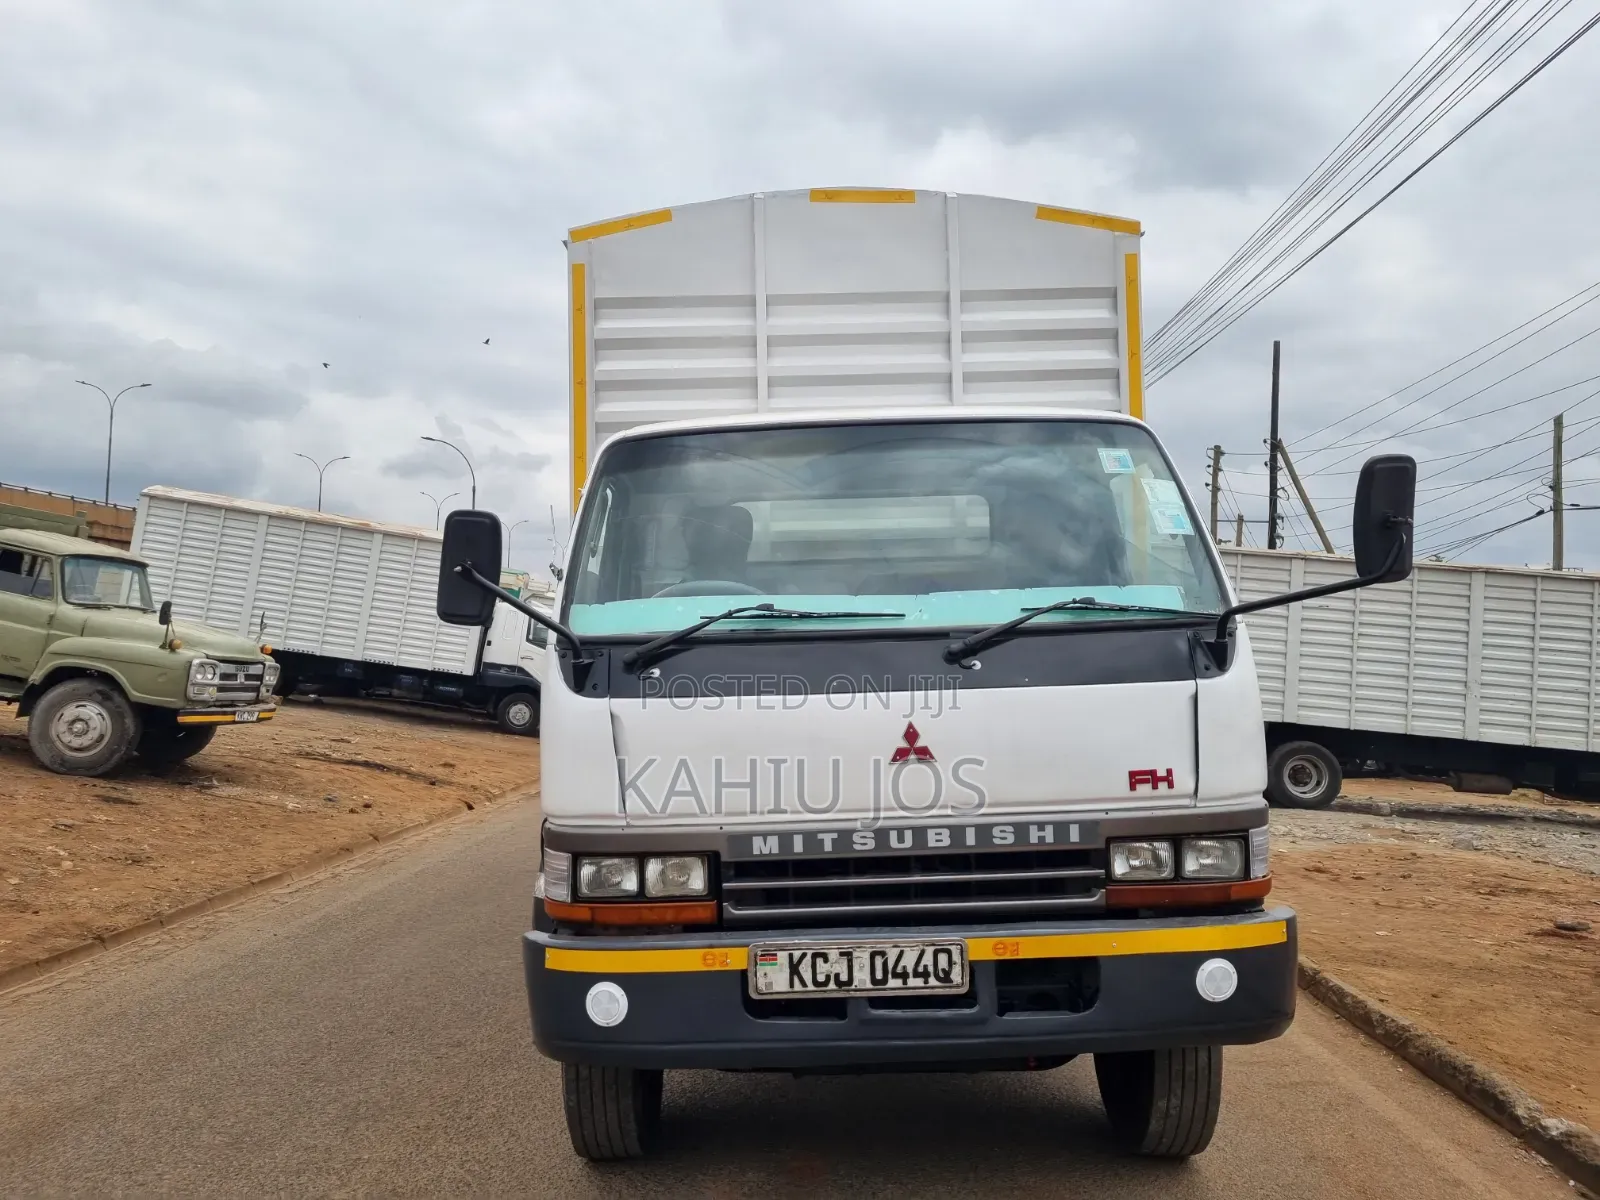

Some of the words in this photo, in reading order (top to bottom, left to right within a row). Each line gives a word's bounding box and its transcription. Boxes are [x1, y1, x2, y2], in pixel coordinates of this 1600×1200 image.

[1128, 768, 1174, 791] FH
[752, 824, 1080, 855] MITSUBISHI
[788, 951, 853, 989] KCJ
[869, 948, 954, 987] 044Q
